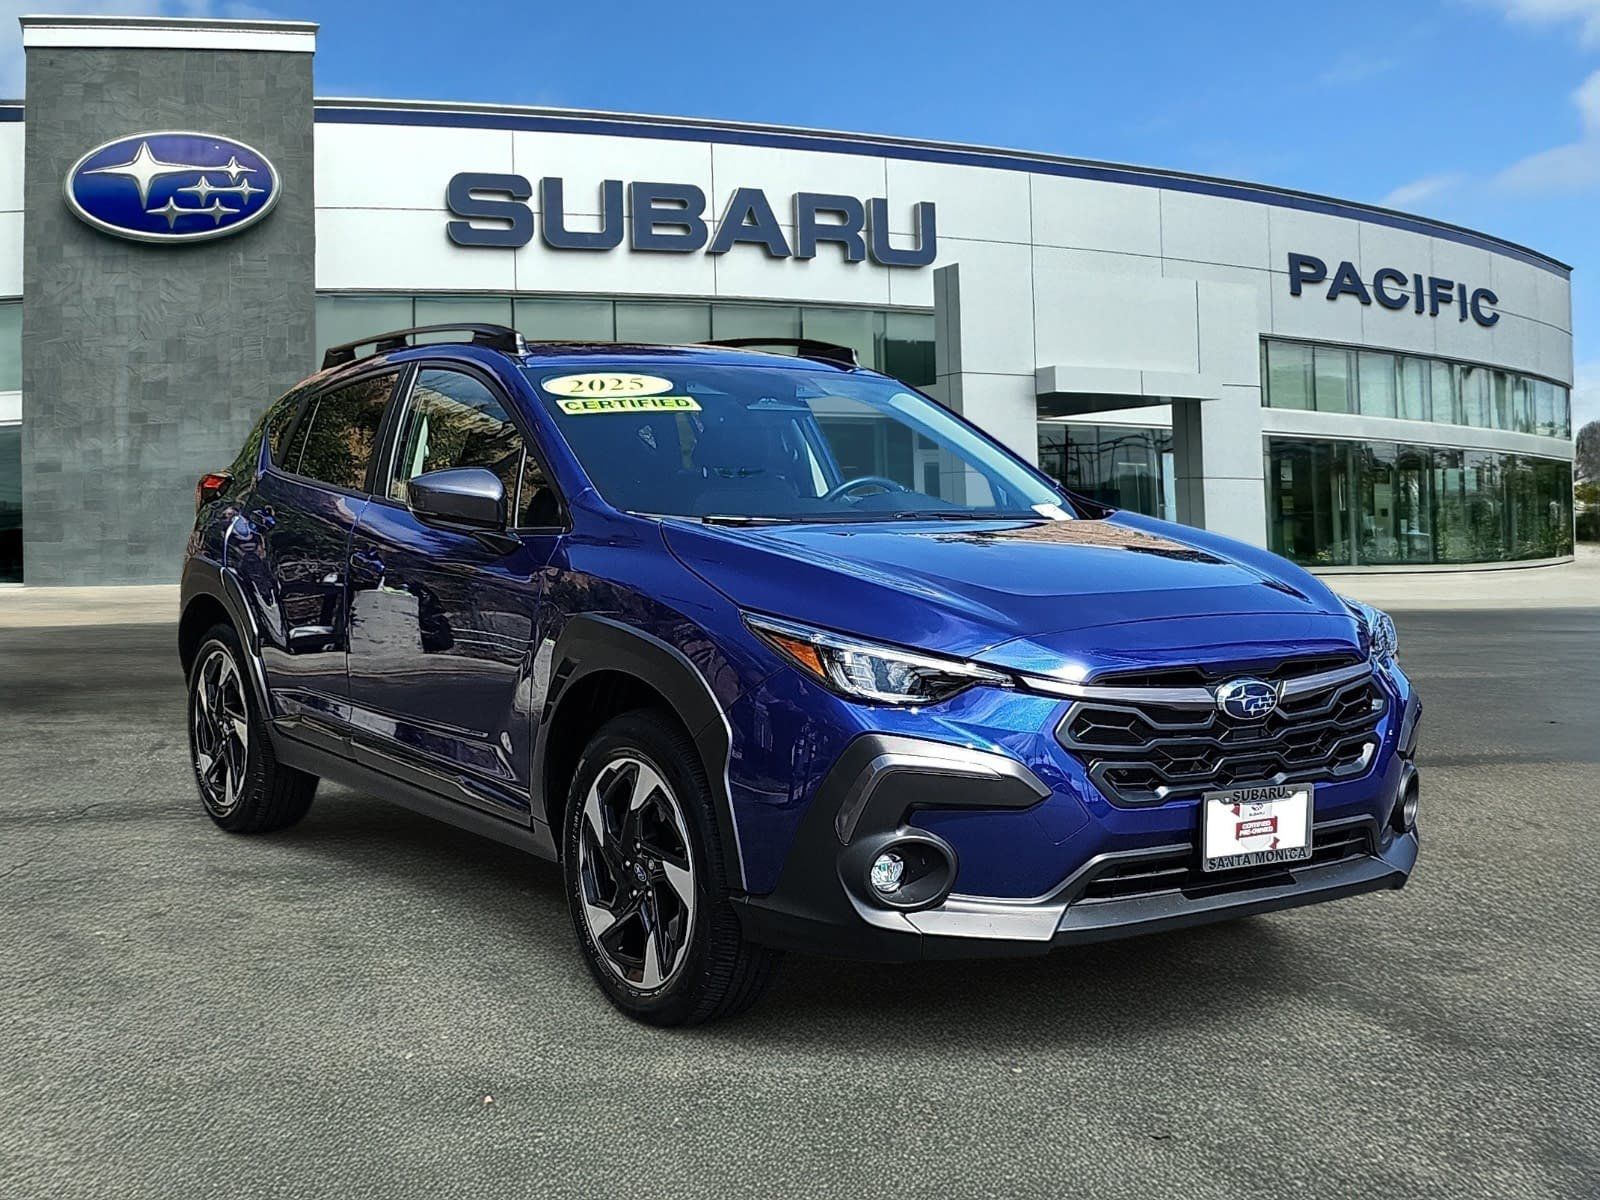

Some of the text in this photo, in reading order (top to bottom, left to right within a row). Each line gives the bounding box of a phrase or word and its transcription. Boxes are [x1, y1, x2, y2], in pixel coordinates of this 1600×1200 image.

[446, 171, 937, 268] SUBARU
[1288, 252, 1500, 327] PACIFIC
[569, 378, 645, 393] 2025
[564, 399, 691, 411] CERTIFIED
[1232, 786, 1286, 802] SUBARU
[1208, 848, 1307, 870] SANTA MONICA
